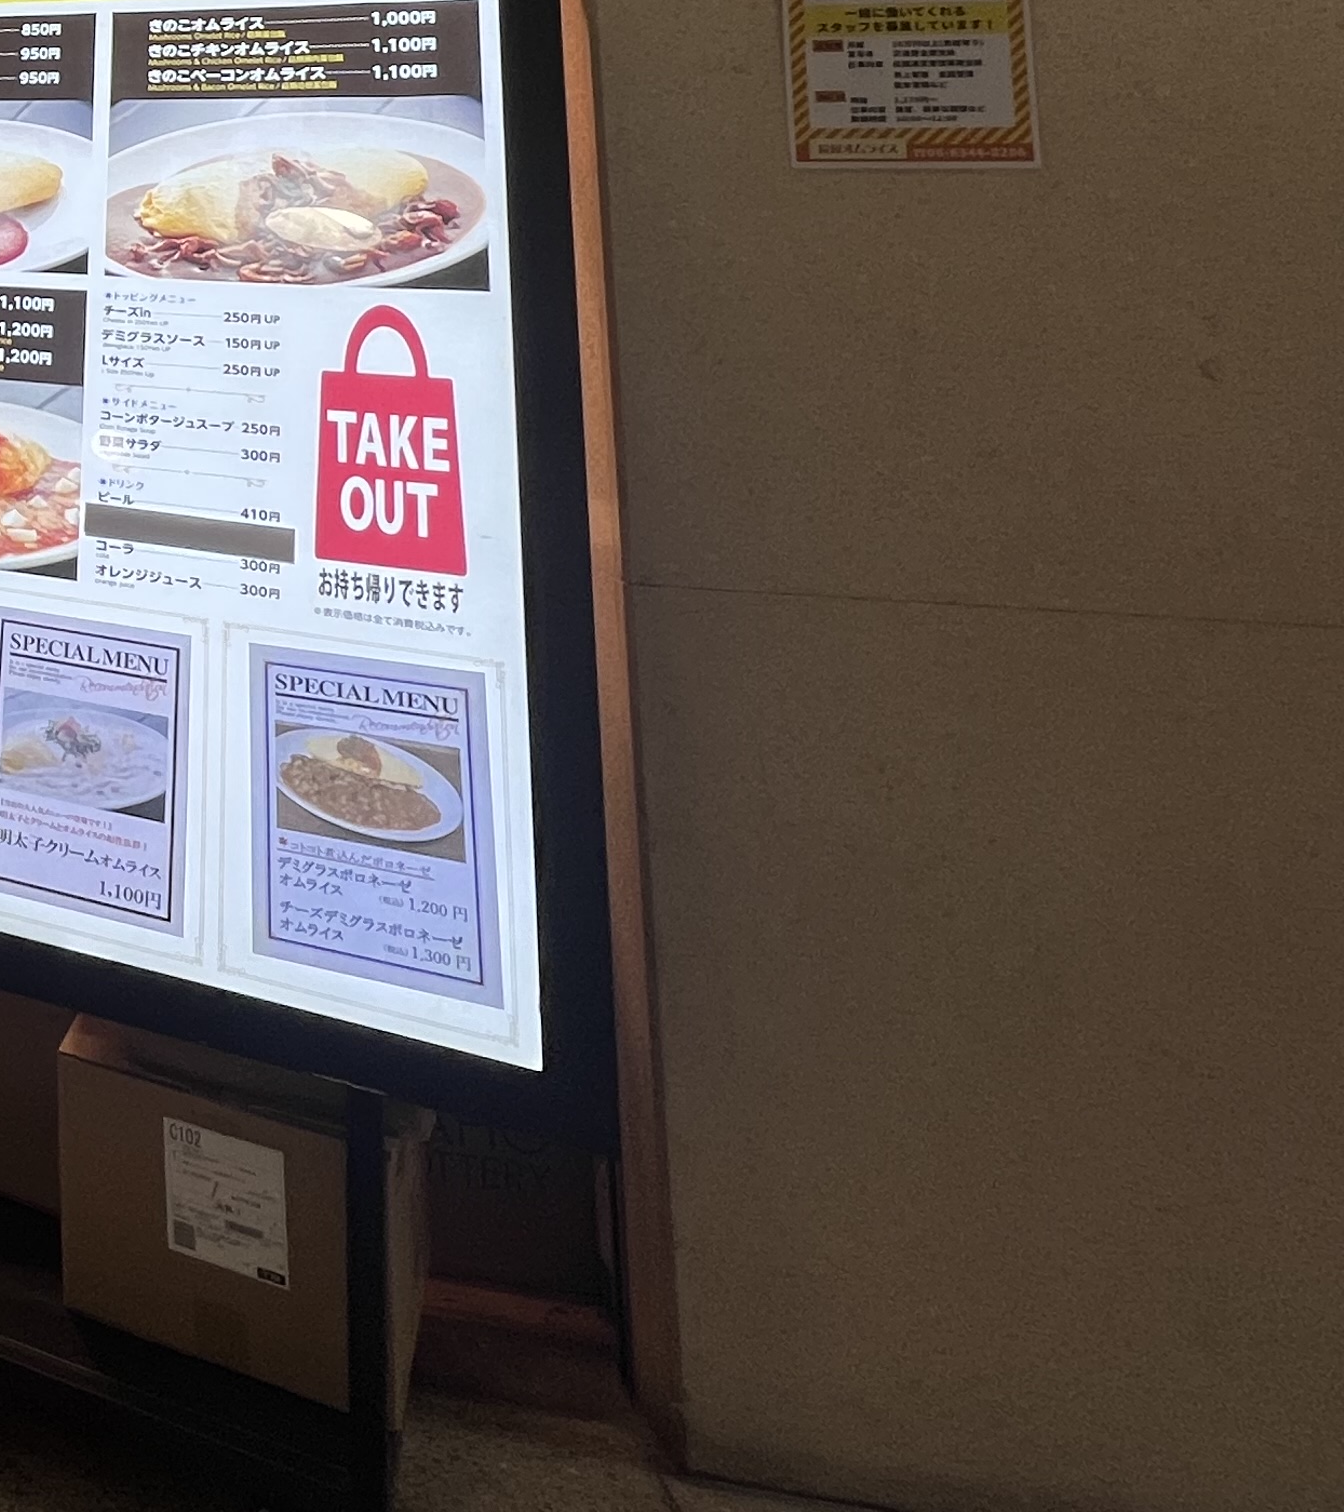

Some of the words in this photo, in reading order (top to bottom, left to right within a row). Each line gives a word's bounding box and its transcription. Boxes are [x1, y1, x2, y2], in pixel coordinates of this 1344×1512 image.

[20, 22, 62, 37] 850円
[148, 16, 265, 33] きのこオムライス
[371, 10, 437, 26] 1,000円
[20, 46, 61, 61] 950円
[147, 40, 311, 58] きのこチキンオムライス
[371, 37, 438, 53] 1,100円
[18, 71, 61, 85] 950円
[147, 66, 327, 84] きのこベーコンオムライス
[372, 64, 439, 80] 1,100円
[0, 294, 55, 313] 1,100円
[103, 305, 152, 319] チーズin
[223, 311, 261, 325] 250円
[264, 315, 281, 325] UP
[101, 329, 206, 348] デミグラスソース
[225, 338, 261, 351] 150円
[264, 341, 281, 351] UP
[101, 354, 146, 369] Lサイズ
[223, 363, 261, 378] 250円
[264, 367, 281, 378] UP
[100, 410, 235, 433] コーンポタージュスープ
[241, 422, 281, 437] 250円
[326, 408, 450, 473] TAKE
[240, 448, 281, 464] 300円
[98, 491, 135, 506] ビール
[240, 507, 281, 523] 410円
[340, 475, 439, 539] OUT
[95, 539, 135, 555] コーラ
[240, 558, 281, 575] 300円
[95, 564, 202, 590] オレンジジュース
[240, 583, 281, 600] 300円
[318, 567, 464, 613] お持ち帰りできます
[10, 632, 100, 665] SPECIAL
[102, 647, 170, 676] MENU
[275, 672, 380, 704] SPECIAL
[381, 689, 459, 716] MENU
[99, 880, 162, 911] 1,100円
[279, 873, 343, 897] オムライス
[452, 904, 469, 923] 円
[280, 918, 344, 941] オムライス
[456, 954, 472, 973] 円
[169, 1123, 201, 1149] C102
